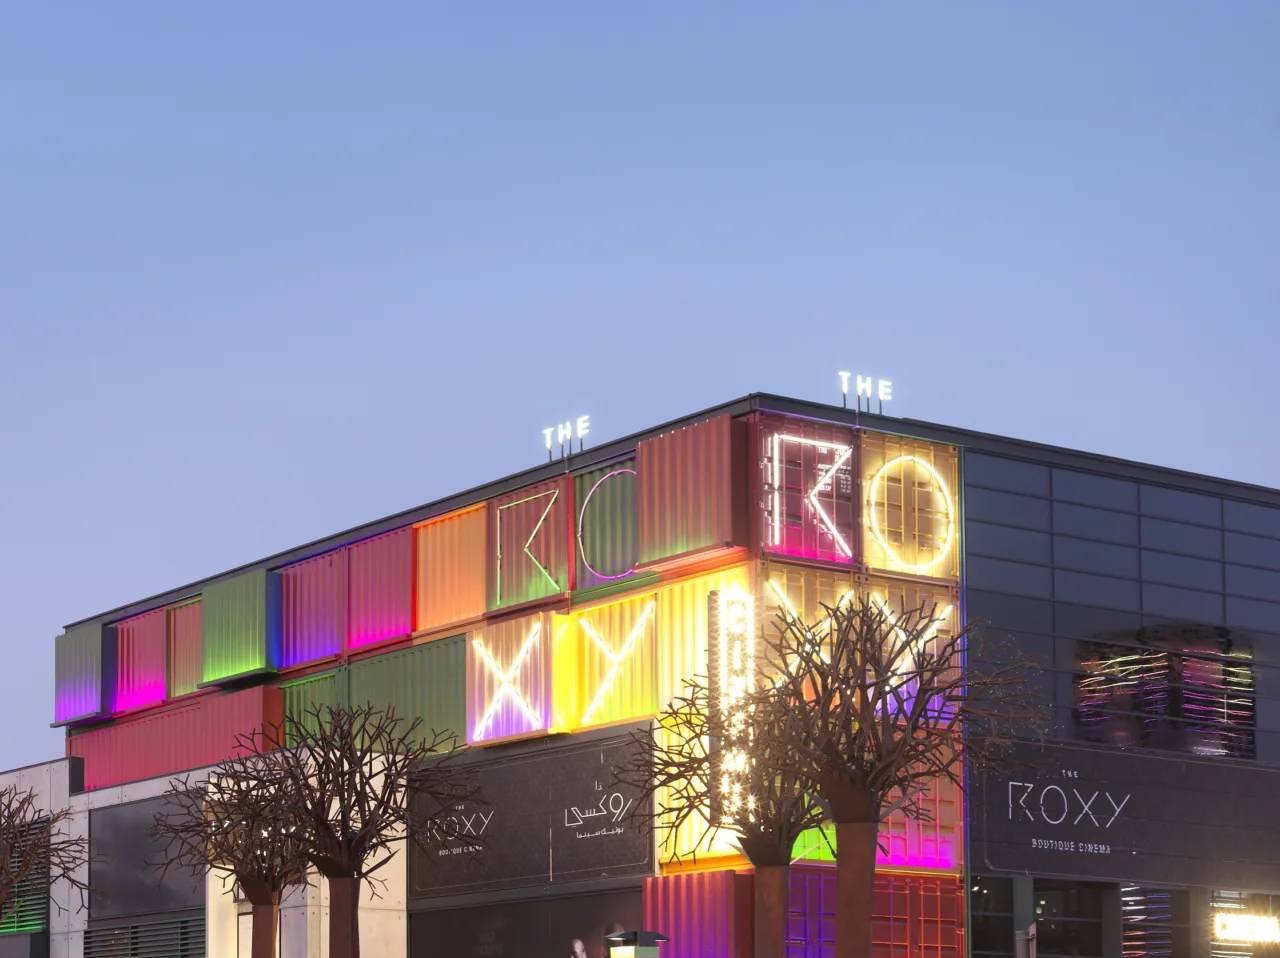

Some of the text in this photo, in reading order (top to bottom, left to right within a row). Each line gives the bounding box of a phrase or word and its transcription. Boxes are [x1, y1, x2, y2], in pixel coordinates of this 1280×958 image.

[838, 371, 892, 401] THE
[542, 415, 590, 450] THE
[1061, 769, 1079, 779] THE
[1008, 781, 1131, 828] ROXY
[427, 810, 494, 843] ROXY
[1031, 838, 1111, 854] BOUTIQUE CINEMA
